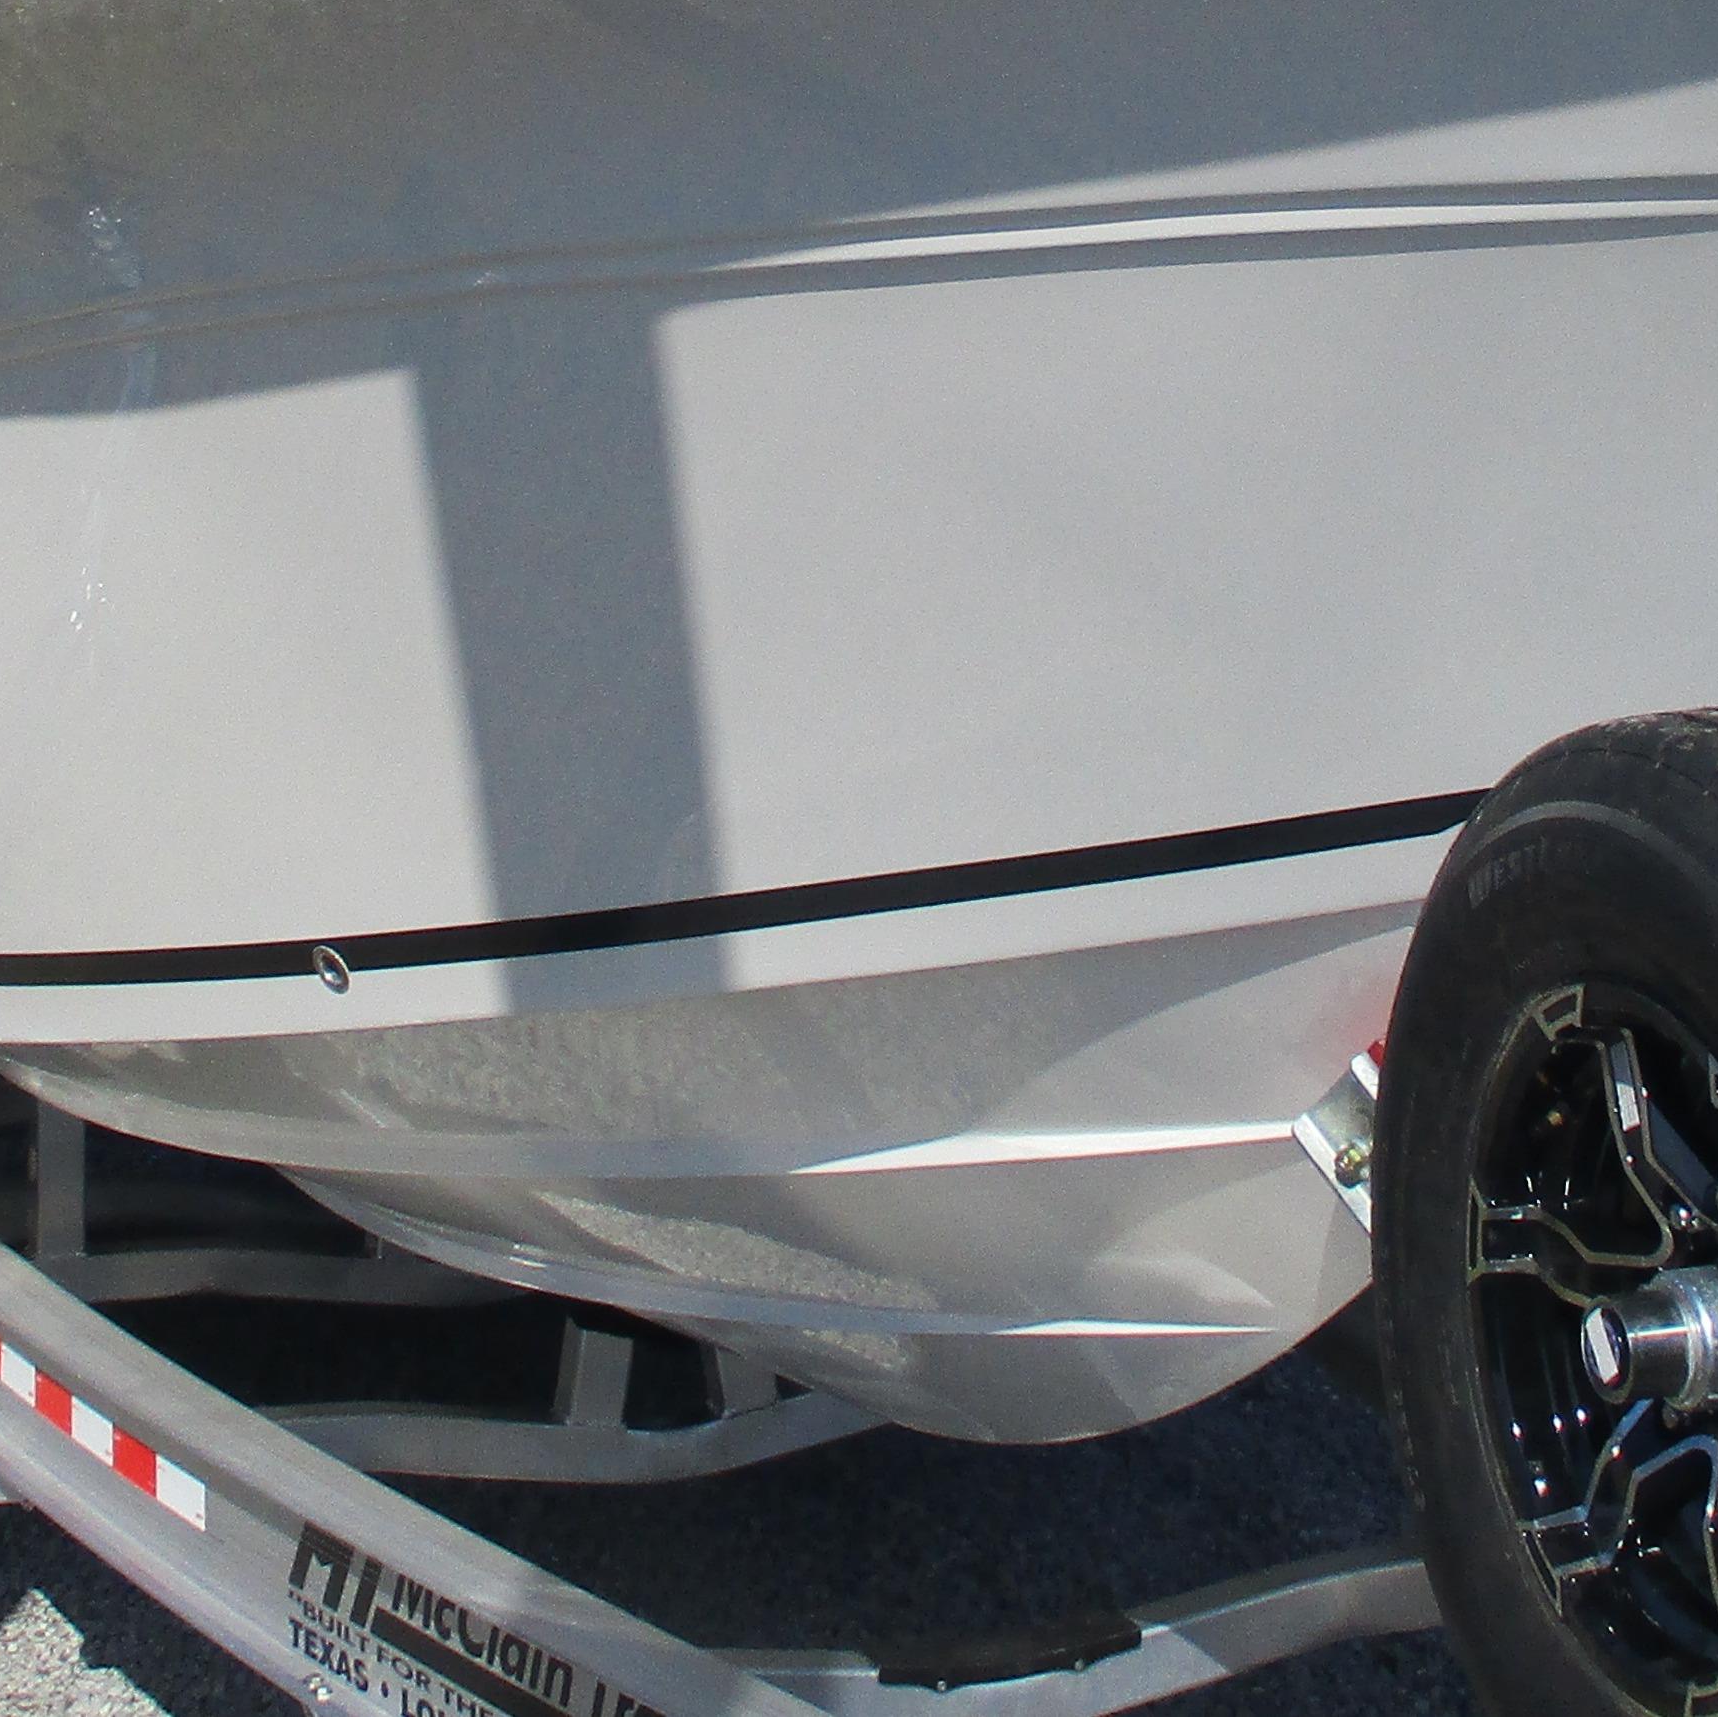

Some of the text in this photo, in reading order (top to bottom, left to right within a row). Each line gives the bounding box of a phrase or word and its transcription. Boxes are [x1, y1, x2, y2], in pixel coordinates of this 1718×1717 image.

[288, 1616, 369, 1694] TEXAS
[376, 1644, 433, 1694] FOR
[391, 1572, 575, 1709] McClain
